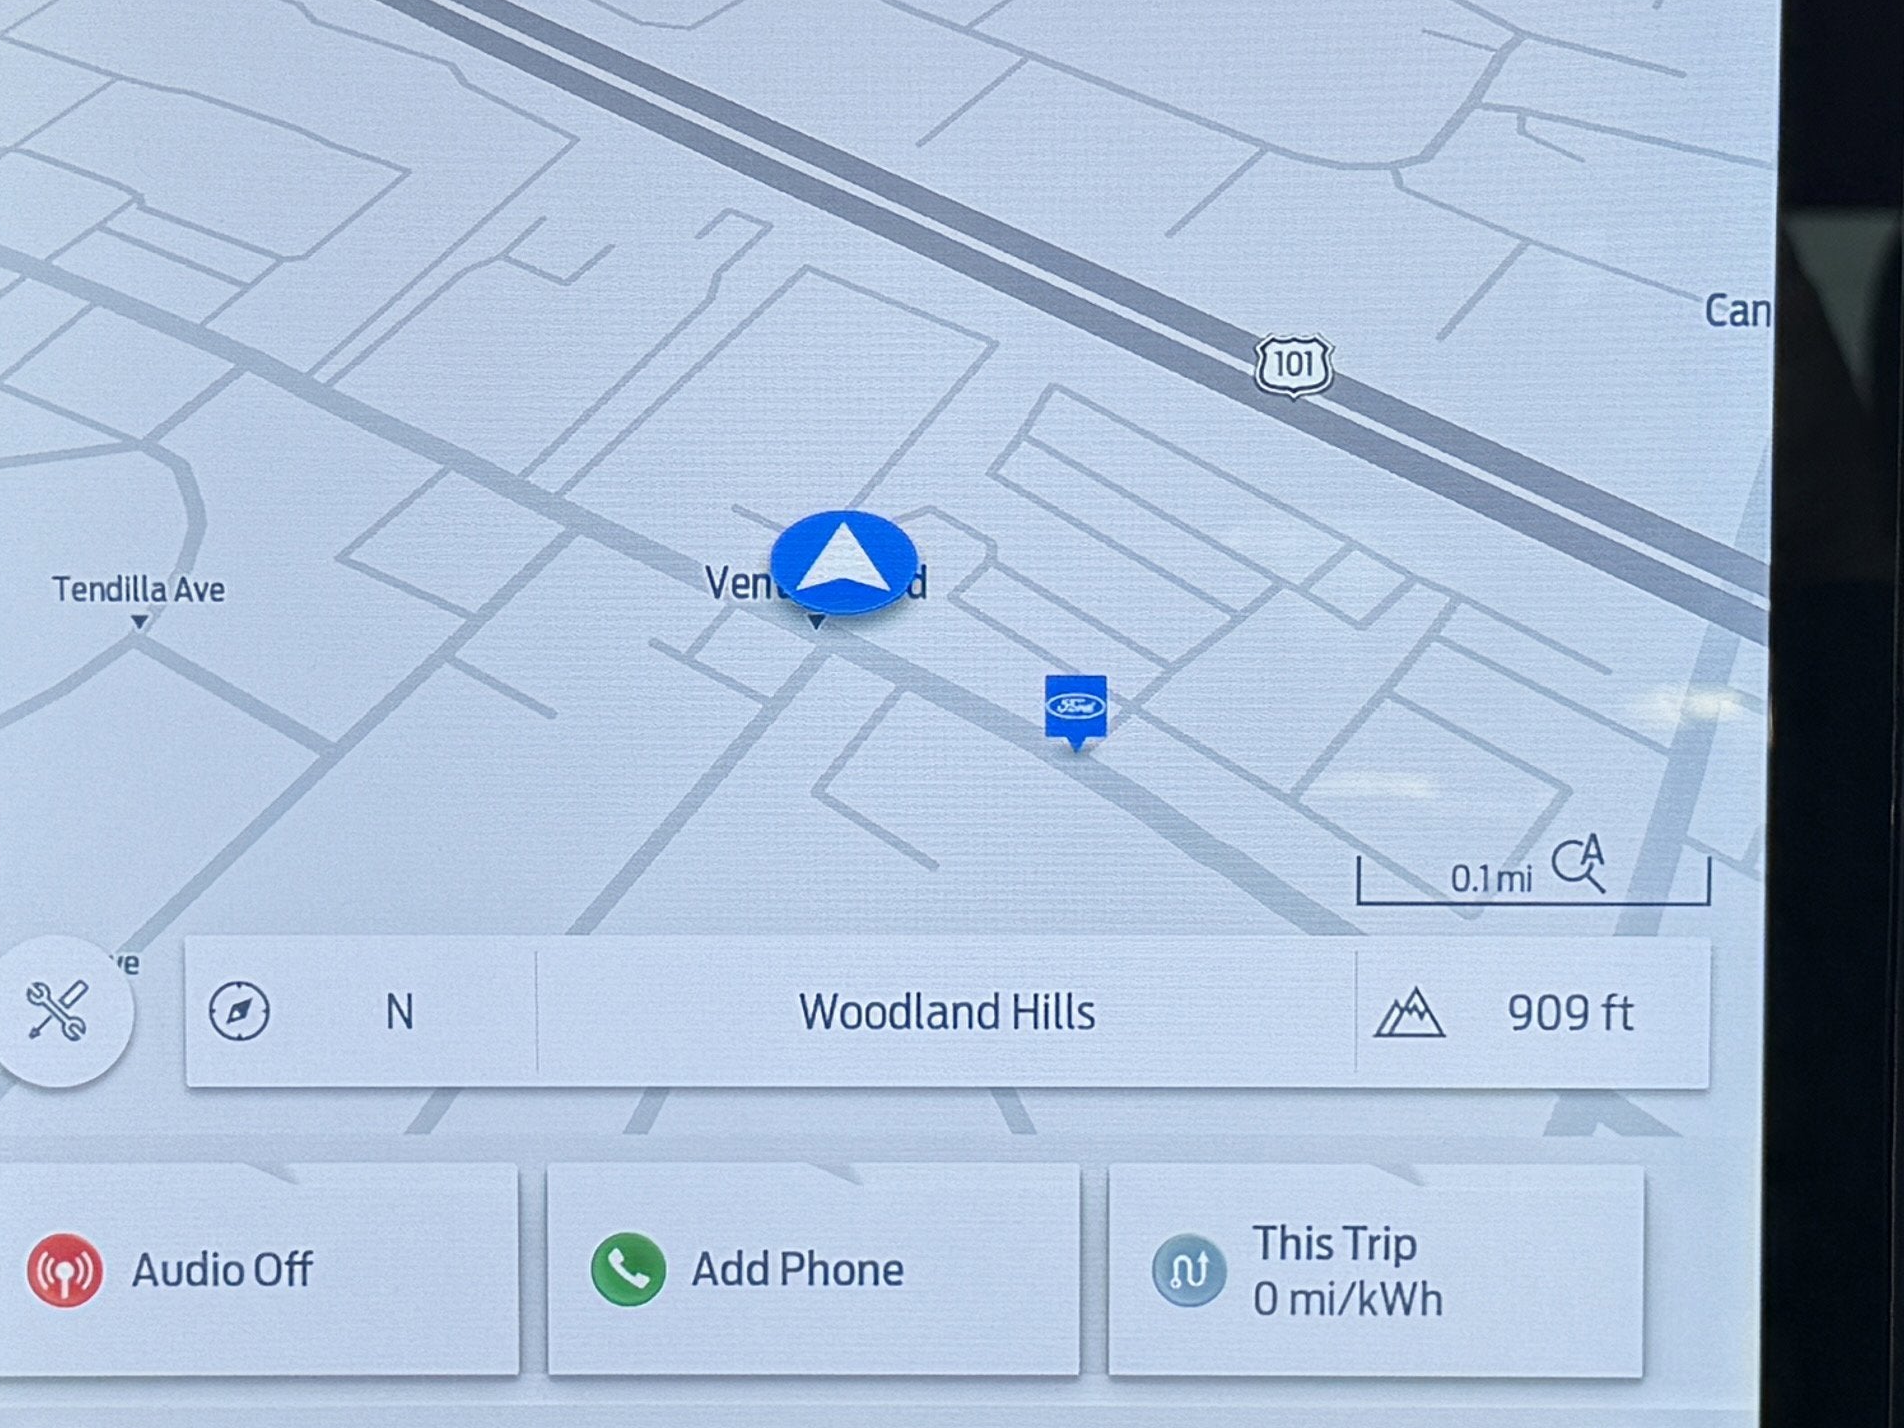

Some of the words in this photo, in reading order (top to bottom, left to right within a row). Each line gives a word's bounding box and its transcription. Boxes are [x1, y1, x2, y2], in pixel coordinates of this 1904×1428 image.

[1274, 350, 1313, 377] 101
[51, 574, 168, 603] Tendilla
[173, 576, 225, 603] Ave
[387, 992, 413, 1030] N
[799, 991, 1000, 1030] Woodland
[1013, 991, 1096, 1030] Hills
[1508, 993, 1589, 1032] 909
[1601, 992, 1635, 1032] ft
[1252, 1223, 1334, 1261] This
[1341, 1225, 1417, 1269] Trip
[131, 1249, 245, 1288] Audio
[254, 1249, 314, 1287] Off
[691, 1249, 769, 1287] Add
[781, 1249, 904, 1287] Phone
[1254, 1280, 1278, 1316] 0
[1290, 1279, 1443, 1317] mi/kWh
